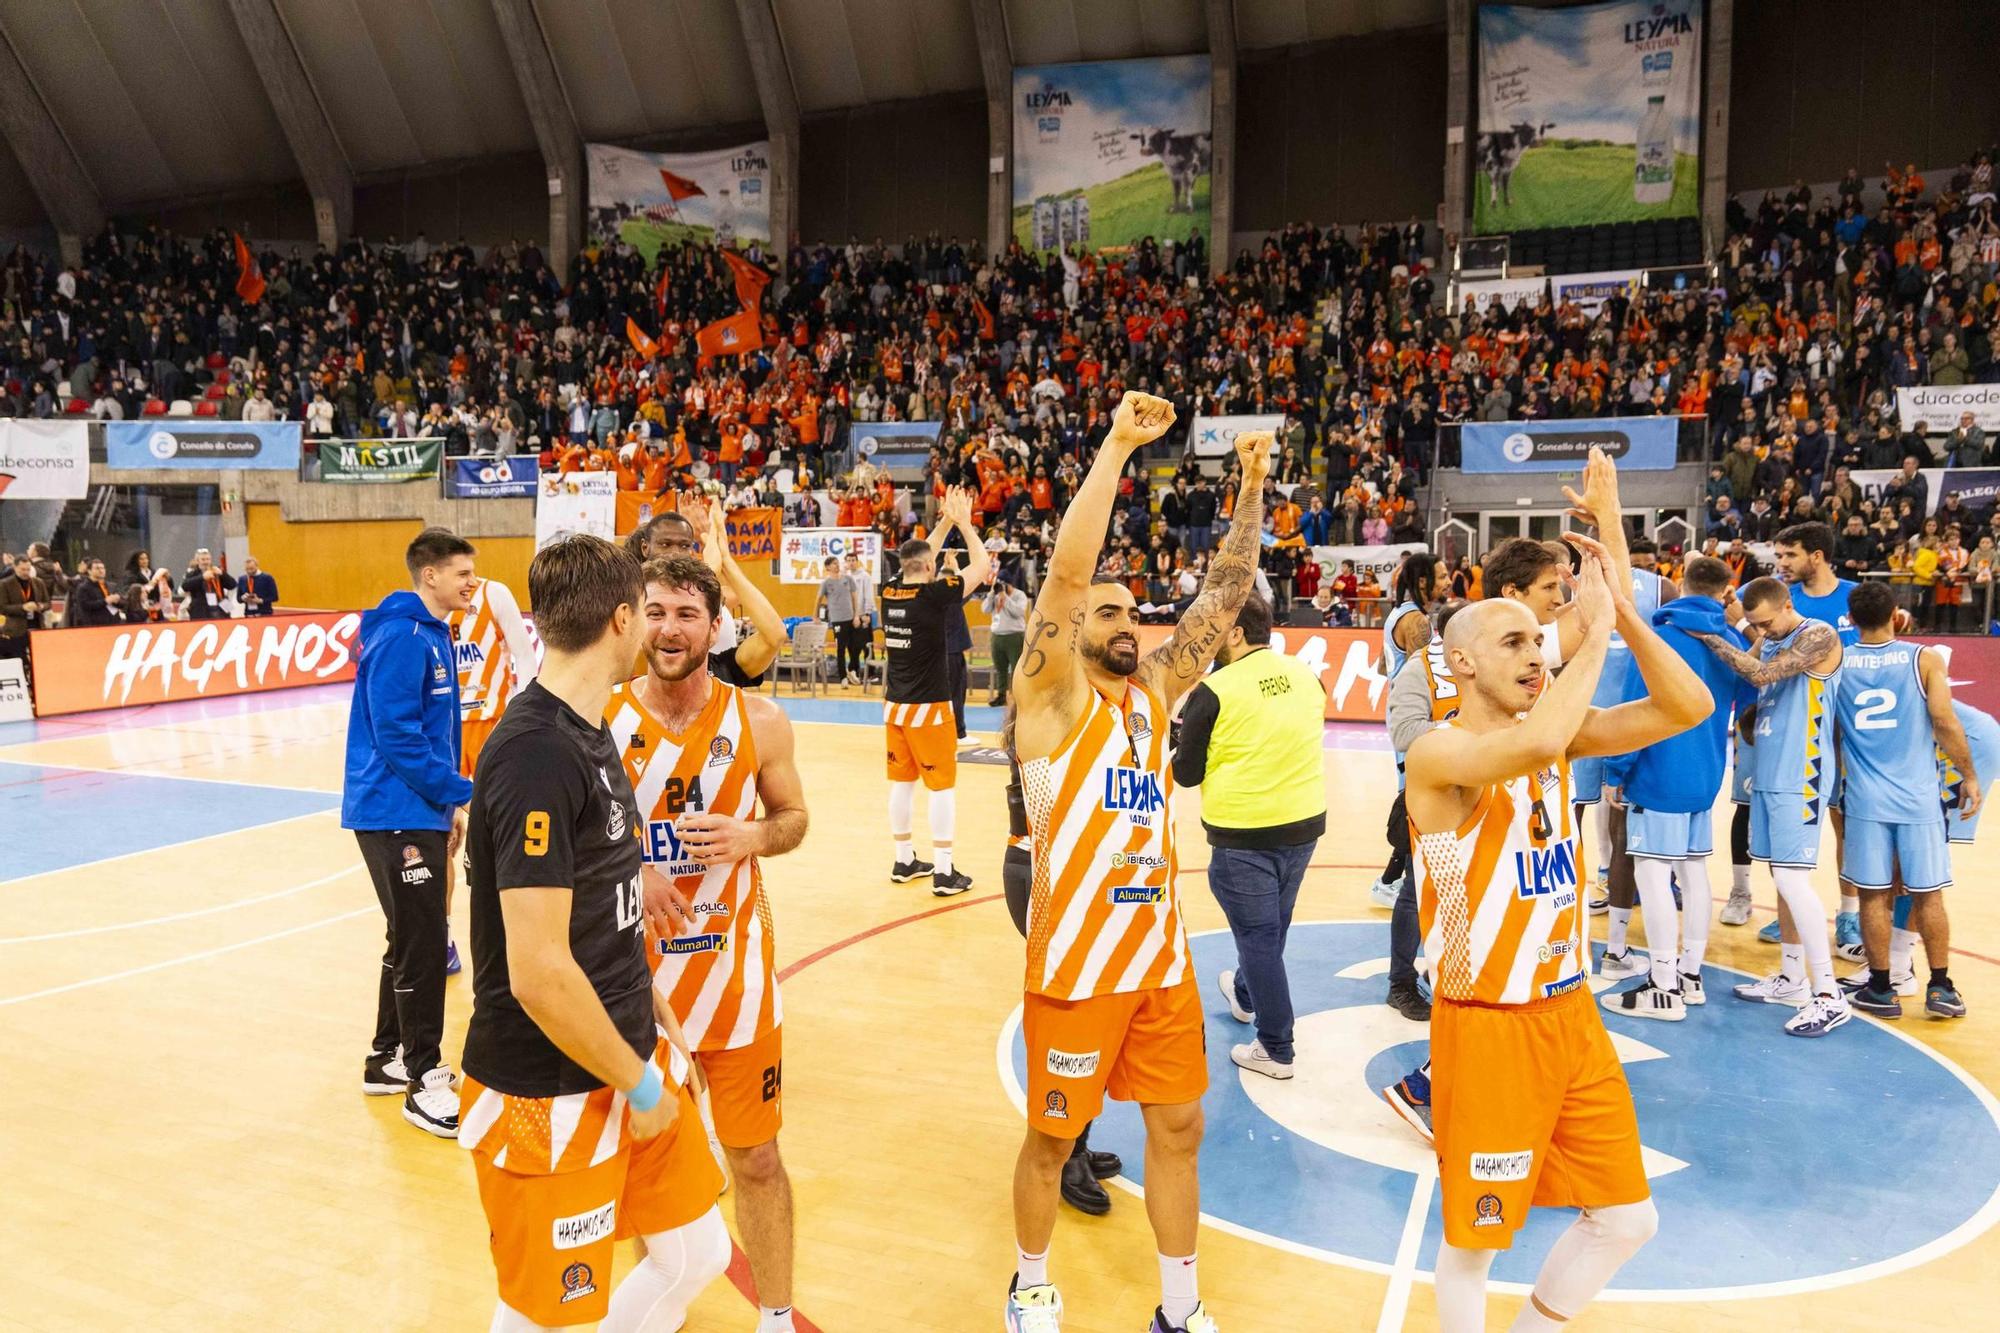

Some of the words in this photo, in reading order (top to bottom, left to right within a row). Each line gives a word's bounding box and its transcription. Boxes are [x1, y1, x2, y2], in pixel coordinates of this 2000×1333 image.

[1624, 13, 1692, 44] LEYMA
[1634, 36, 1680, 53] NATURA
[1026, 91, 1072, 108] LEYMA
[732, 157, 768, 172] LEYMA
[1913, 389, 2000, 405] duacode
[340, 445, 423, 466] MASTIL
[1537, 441, 1573, 452] Concello
[1575, 441, 1587, 451] da
[726, 521, 772, 537] NAMI
[104, 612, 361, 706] HAGAMOS
[1258, 674, 1293, 699] PRENSA
[1854, 688, 1898, 731] 2
[665, 775, 704, 814] 24
[524, 811, 551, 857] 9
[401, 866, 433, 883] LEYMA
[670, 863, 707, 875] NATURA
[666, 938, 709, 953] Aluman
[1475, 1157, 1511, 1178] HAGAMOS
[558, 1214, 599, 1243] HAGAMOS
